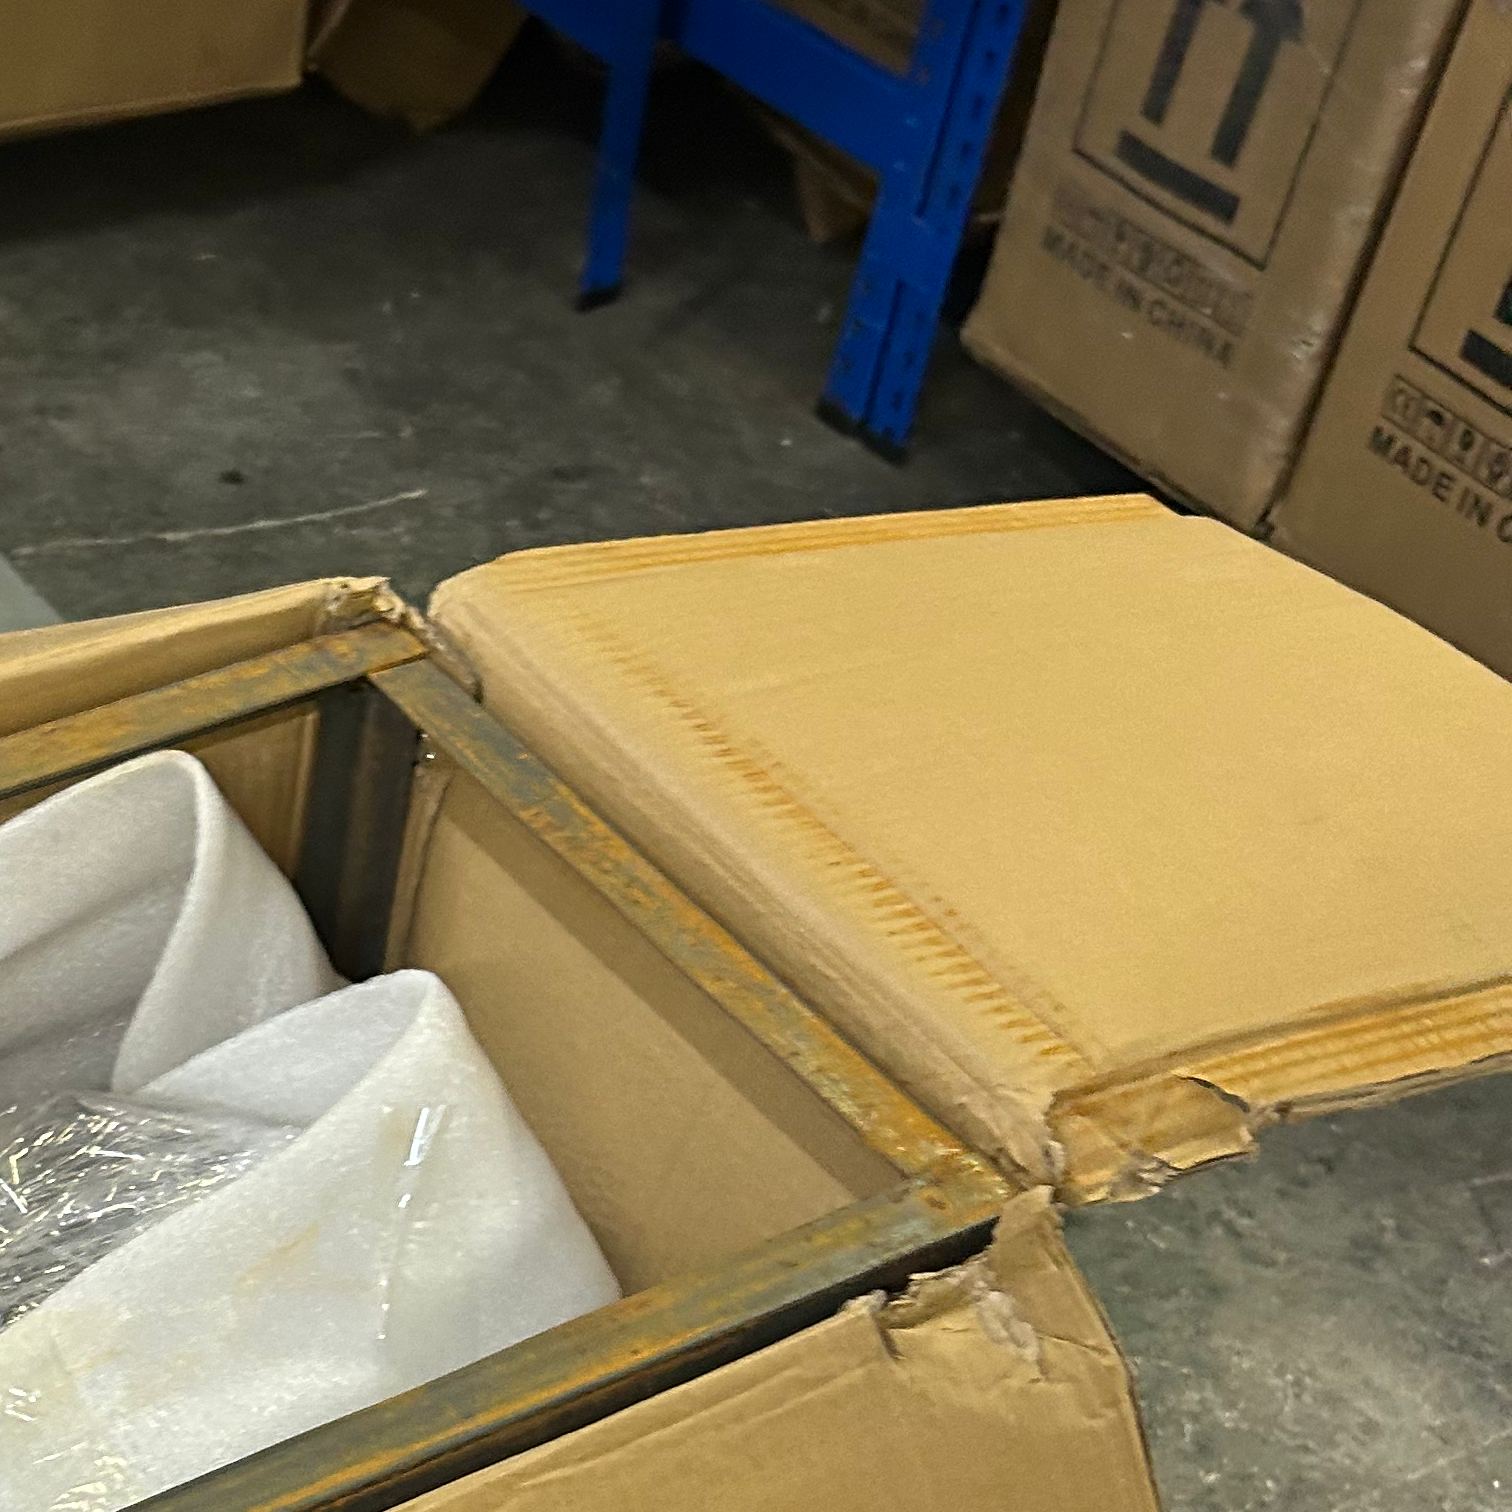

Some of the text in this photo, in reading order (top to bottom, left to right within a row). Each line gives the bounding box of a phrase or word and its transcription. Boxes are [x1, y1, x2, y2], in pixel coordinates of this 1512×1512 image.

[1042, 223, 1234, 370] MADE IN CHINA
[1369, 424, 1455, 502] MADE
[1456, 486, 1493, 528] IN
